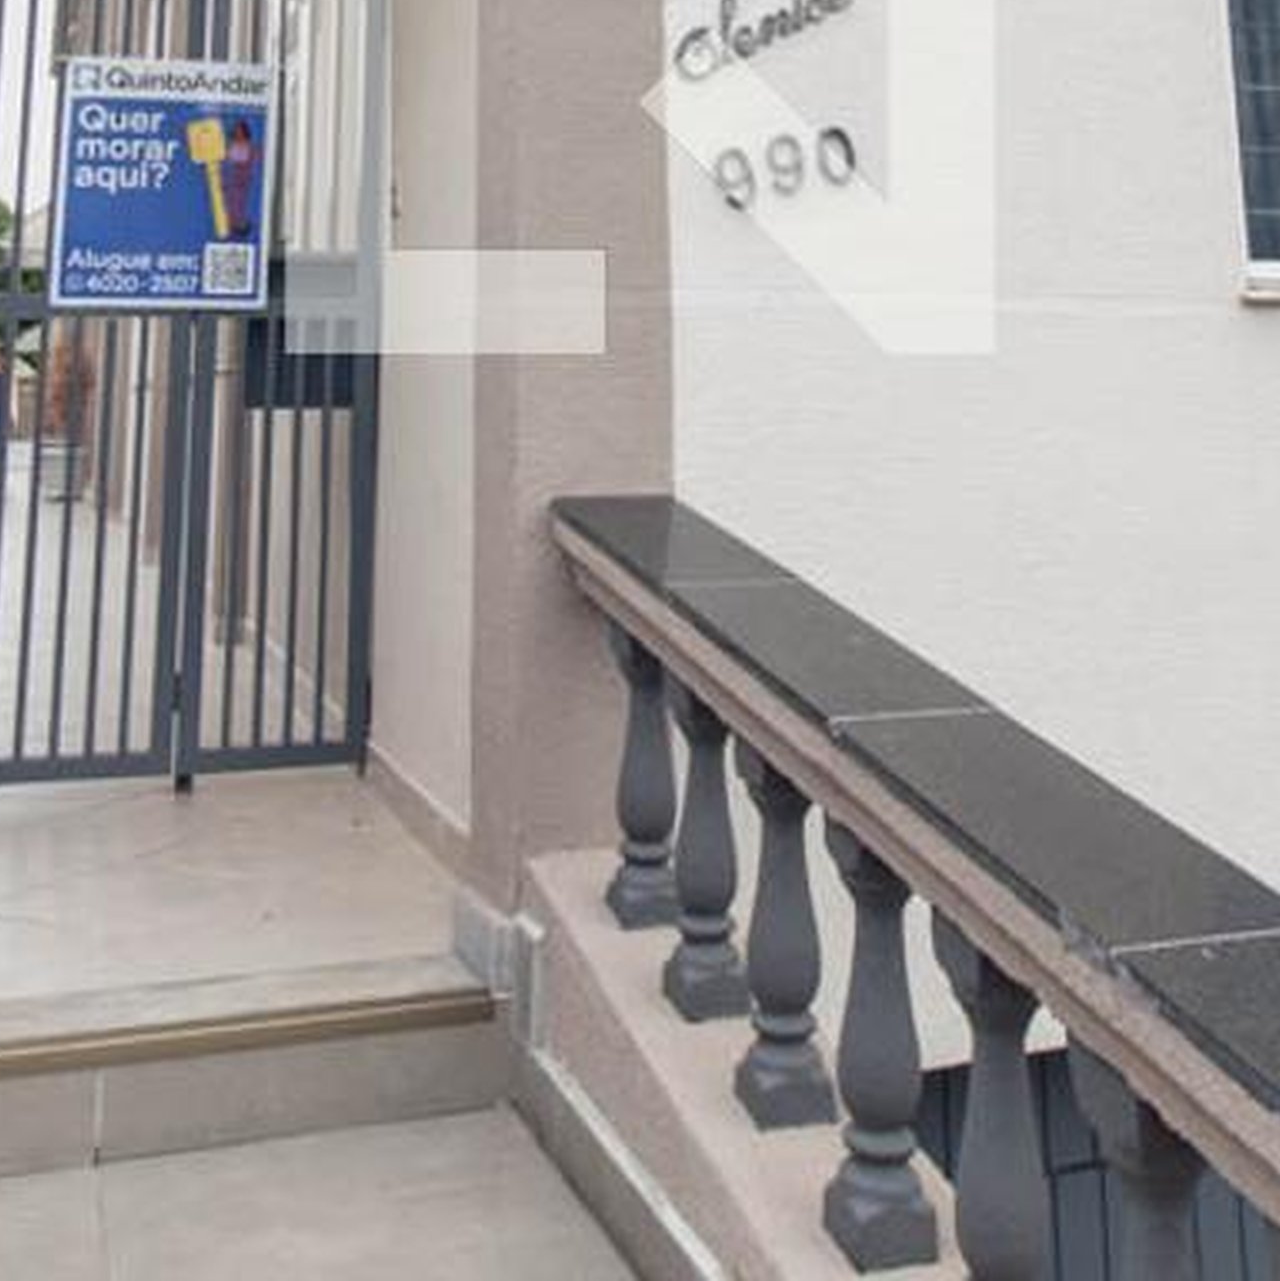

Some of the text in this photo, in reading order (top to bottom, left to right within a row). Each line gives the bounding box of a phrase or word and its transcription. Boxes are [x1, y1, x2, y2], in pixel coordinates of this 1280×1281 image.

[105, 67, 269, 96] QuintoAndar
[78, 103, 166, 134] Quer
[76, 137, 180, 161] morar
[74, 162, 170, 194] aqui?
[714, 125, 856, 213] 990
[66, 248, 152, 272] Alugue
